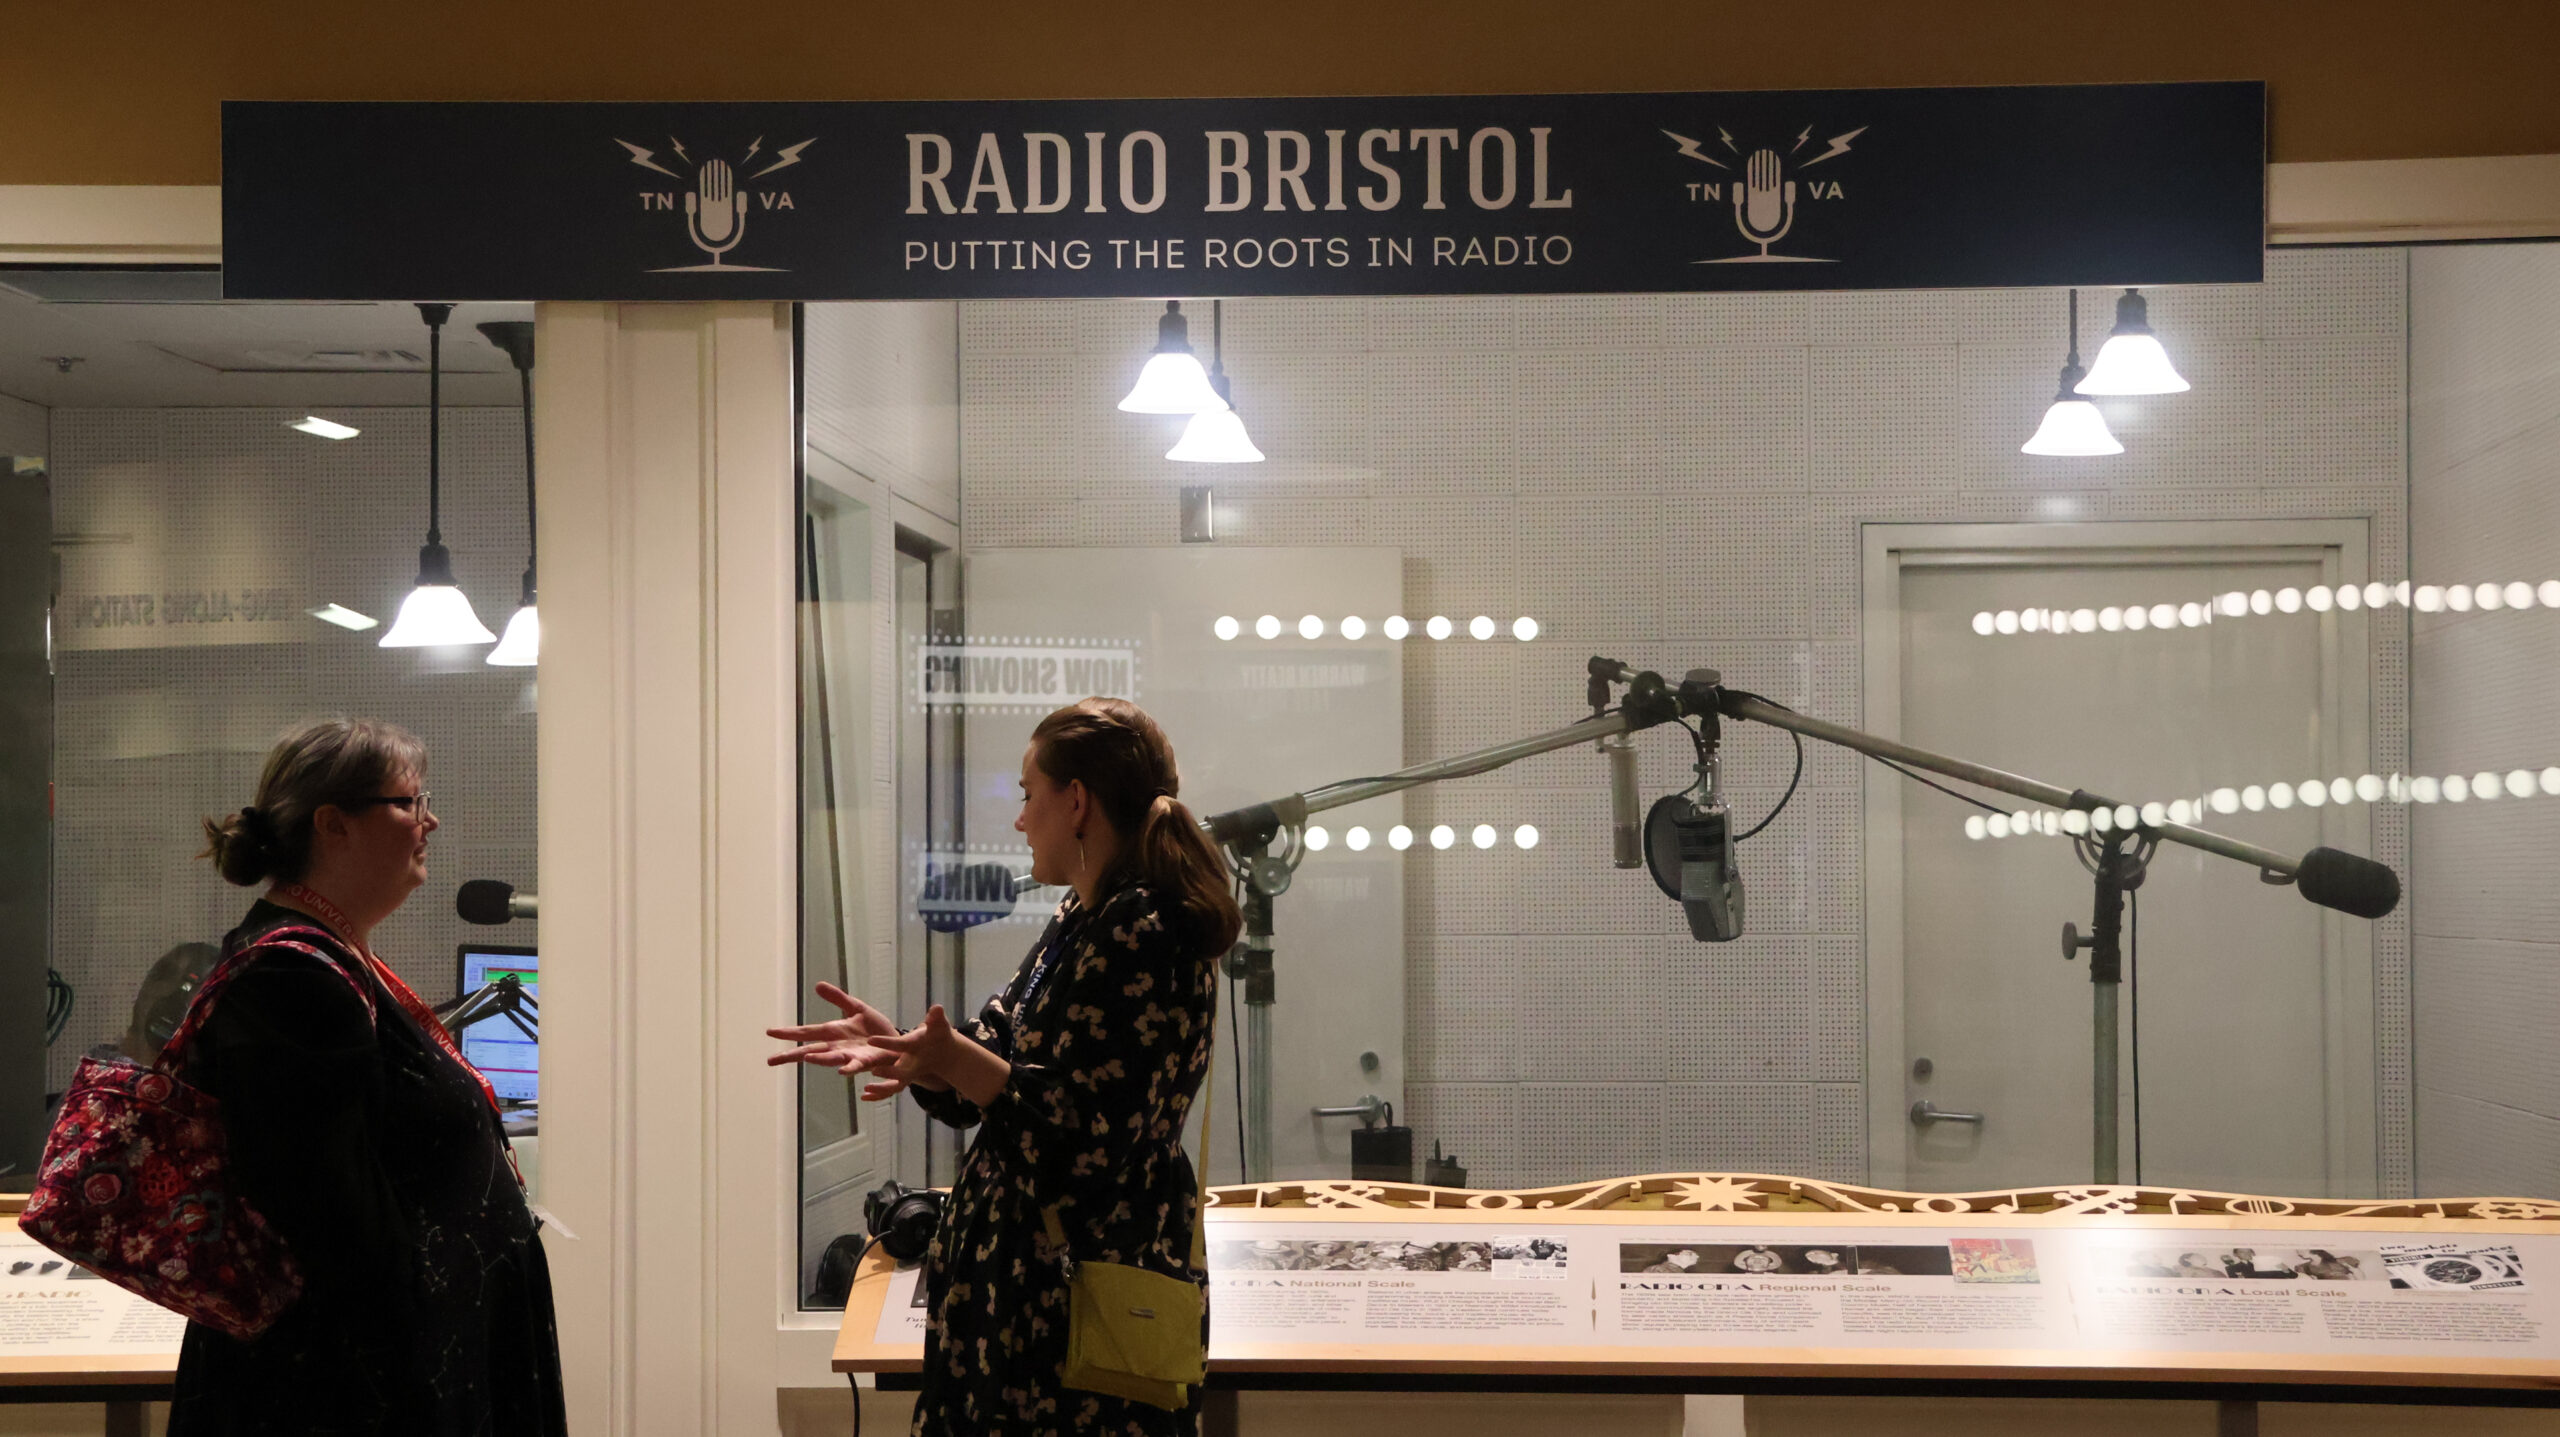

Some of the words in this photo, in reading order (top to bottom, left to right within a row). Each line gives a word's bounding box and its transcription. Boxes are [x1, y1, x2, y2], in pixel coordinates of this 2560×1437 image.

[906, 131, 1168, 215] RADIO
[1204, 127, 1573, 213] BRISTOL
[1687, 184, 1720, 201] TN
[1809, 182, 1844, 200] VA
[640, 193, 673, 211] TN
[760, 192, 795, 210] VA
[905, 240, 1092, 271] PUTTING
[1108, 239, 1186, 270] THE
[1204, 238, 1350, 269] ROOTS
[1367, 238, 1413, 267] IN
[1433, 235, 1573, 267] RADIO
[1289, 1280, 1361, 1288] National
[1368, 1280, 1416, 1288] Scale
[1760, 1284, 1836, 1293] Regional
[1841, 1284, 1891, 1292] Scale
[2216, 1288, 2235, 1296] A
[2240, 1288, 2291, 1297] Local
[2296, 1289, 2348, 1298] Scale
